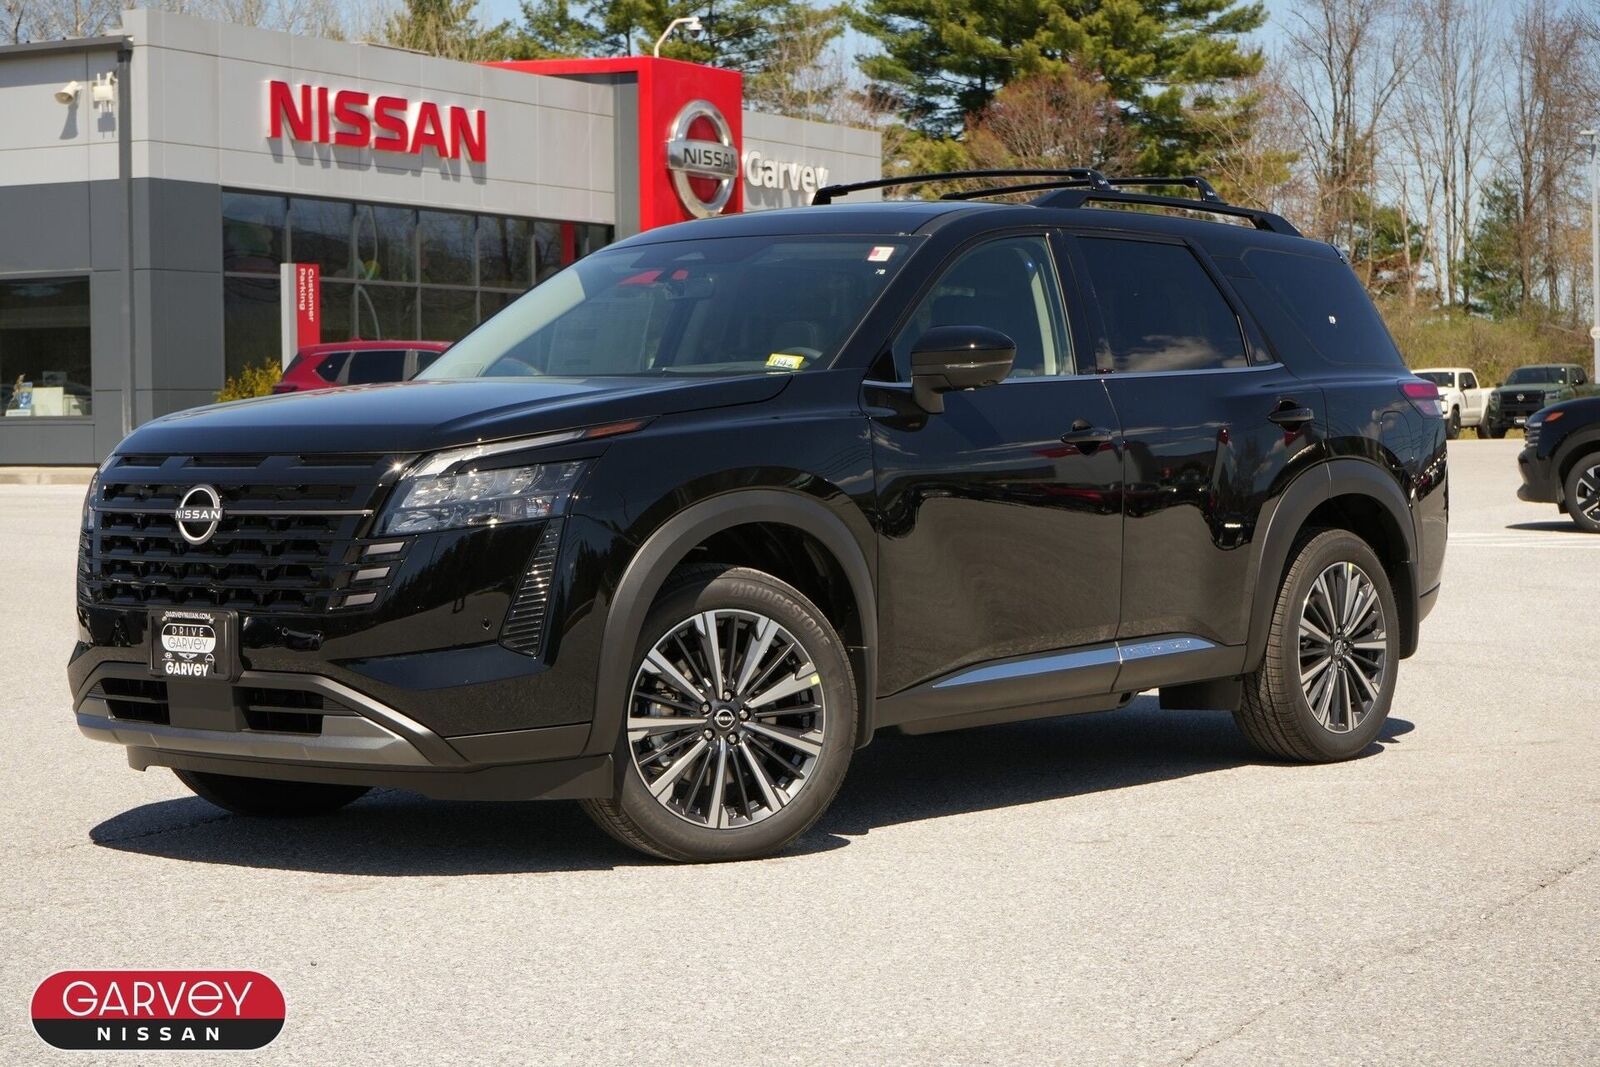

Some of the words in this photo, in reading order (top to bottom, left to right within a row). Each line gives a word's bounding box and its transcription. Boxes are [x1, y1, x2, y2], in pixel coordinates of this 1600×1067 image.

[270, 80, 486, 163] NISSAN
[746, 151, 829, 204] Garvey
[175, 510, 221, 519] NISSAN
[171, 626, 204, 637] DRIVE
